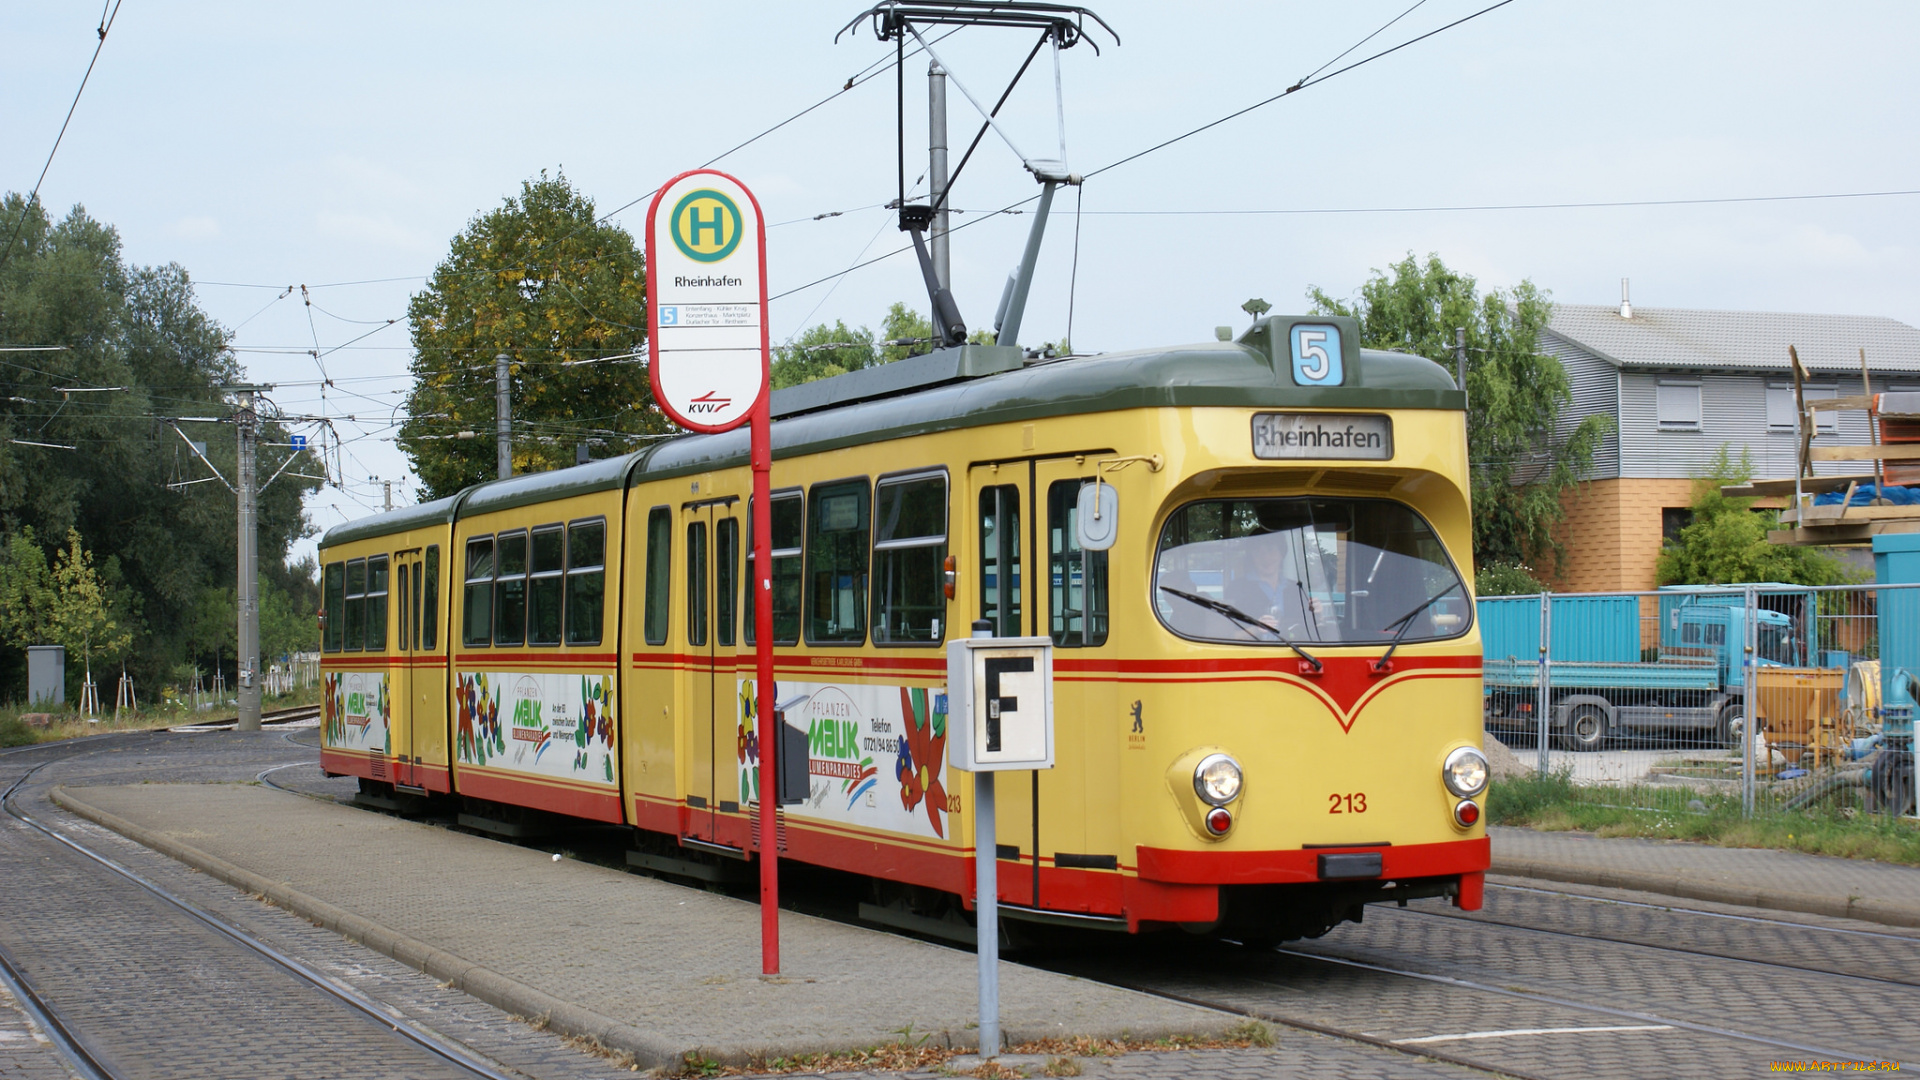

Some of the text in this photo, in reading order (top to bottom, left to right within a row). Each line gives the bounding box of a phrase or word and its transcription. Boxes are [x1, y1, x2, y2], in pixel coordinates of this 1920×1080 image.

[690, 207, 724, 246] H
[674, 275, 742, 288] Rheinhafen
[663, 308, 674, 324] 5
[1298, 330, 1330, 381] 5
[688, 404, 715, 413] KVV
[1255, 424, 1381, 448] Rheinhafen
[812, 701, 850, 717] PFLANZEN
[985, 656, 1034, 752] F
[871, 718, 892, 733] Telefon
[809, 760, 861, 779] LUMENPARADIES
[948, 794, 962, 814] 213
[1328, 792, 1368, 814] 213
